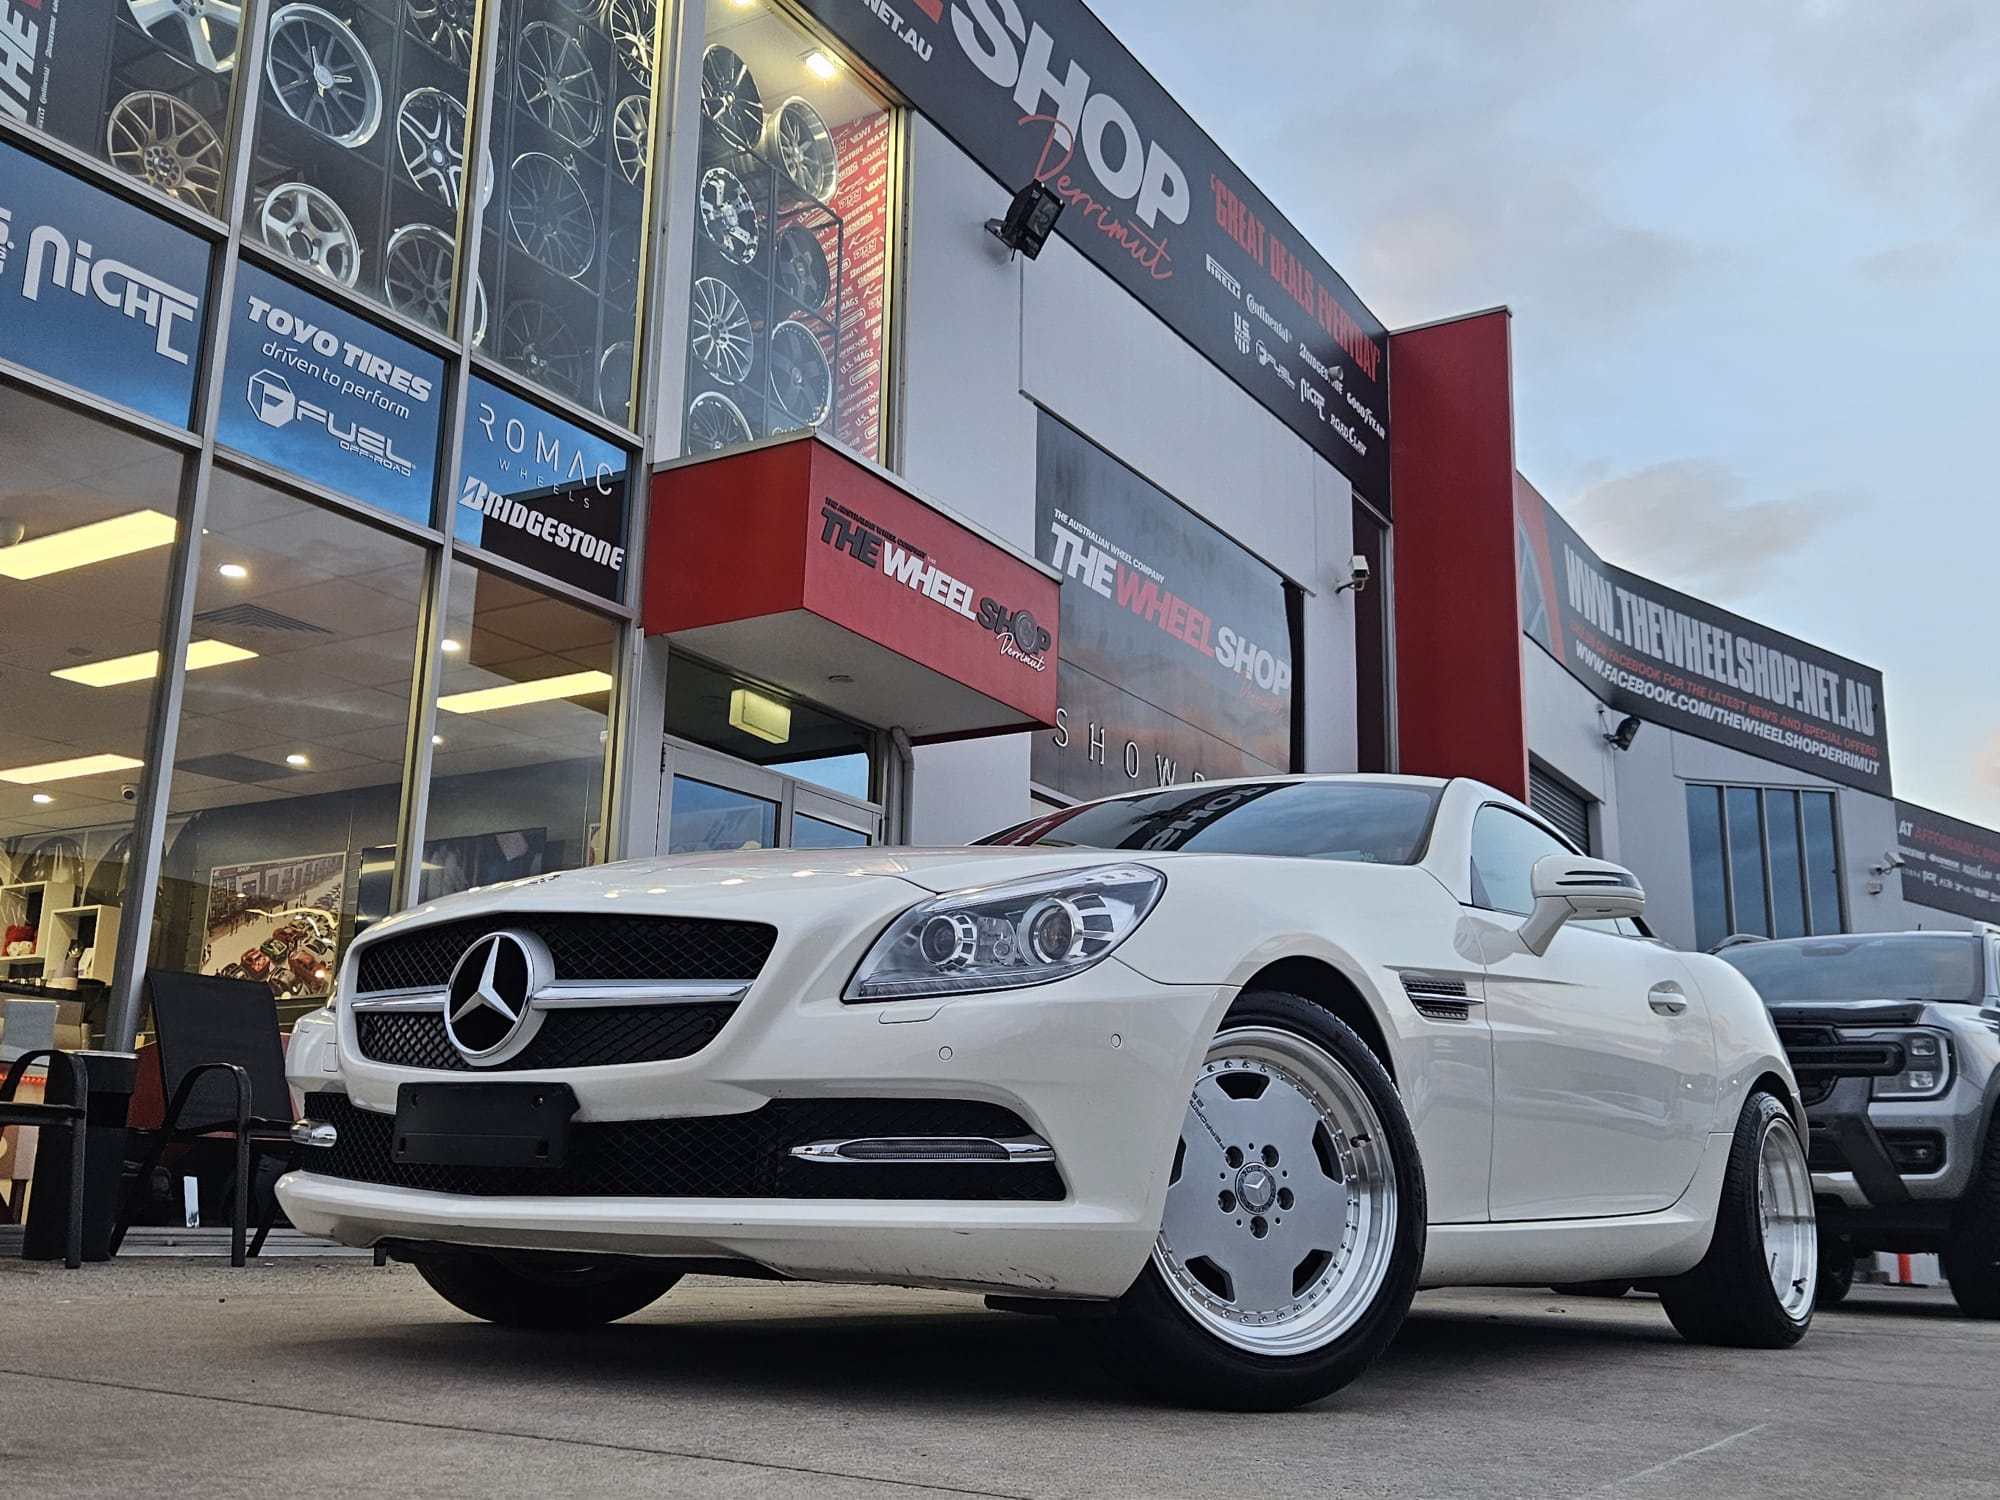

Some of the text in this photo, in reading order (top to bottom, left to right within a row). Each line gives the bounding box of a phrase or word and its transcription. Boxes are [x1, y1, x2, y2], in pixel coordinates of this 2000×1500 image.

[951, 0, 1190, 228] SHOP
[1018, 114, 1173, 280] Derrimut
[1270, 232, 1315, 317] DEALS
[248, 295, 433, 403] TOYO TIRES
[261, 341, 410, 421] driven to perform
[1205, 253, 1241, 300] PIRELLI
[1246, 293, 1290, 345] Continental
[1347, 392, 1386, 441] GOODYEAR
[295, 399, 413, 470] FUEL
[1300, 378, 1326, 422] NICHE
[338, 439, 412, 478] OFF-ROAD
[478, 401, 614, 497] ROMAC
[497, 456, 592, 510] WHEELS
[456, 475, 626, 572] BRIDGESTONE
[1054, 507, 1166, 585] THE AUSTRALIAN WHEEL COMPANY
[820, 506, 1051, 656] THE WHEEL SHOP
[1051, 521, 1292, 696] THE WHEEL SHOP
[1564, 543, 1875, 738] WWW.THEWHEELSHOP.NET.AU
[1608, 648, 1661, 681] FACEBOOK
[1663, 673, 1684, 689] FOR
[1686, 680, 1707, 698] THE
[1708, 690, 1746, 712] LATEST
[1748, 705, 1778, 724] NEWS
[1780, 715, 1801, 734] AND
[1802, 723, 1842, 747] SPECIAL
[1843, 737, 1879, 758] OFFERS
[1898, 820, 1914, 837] AT
